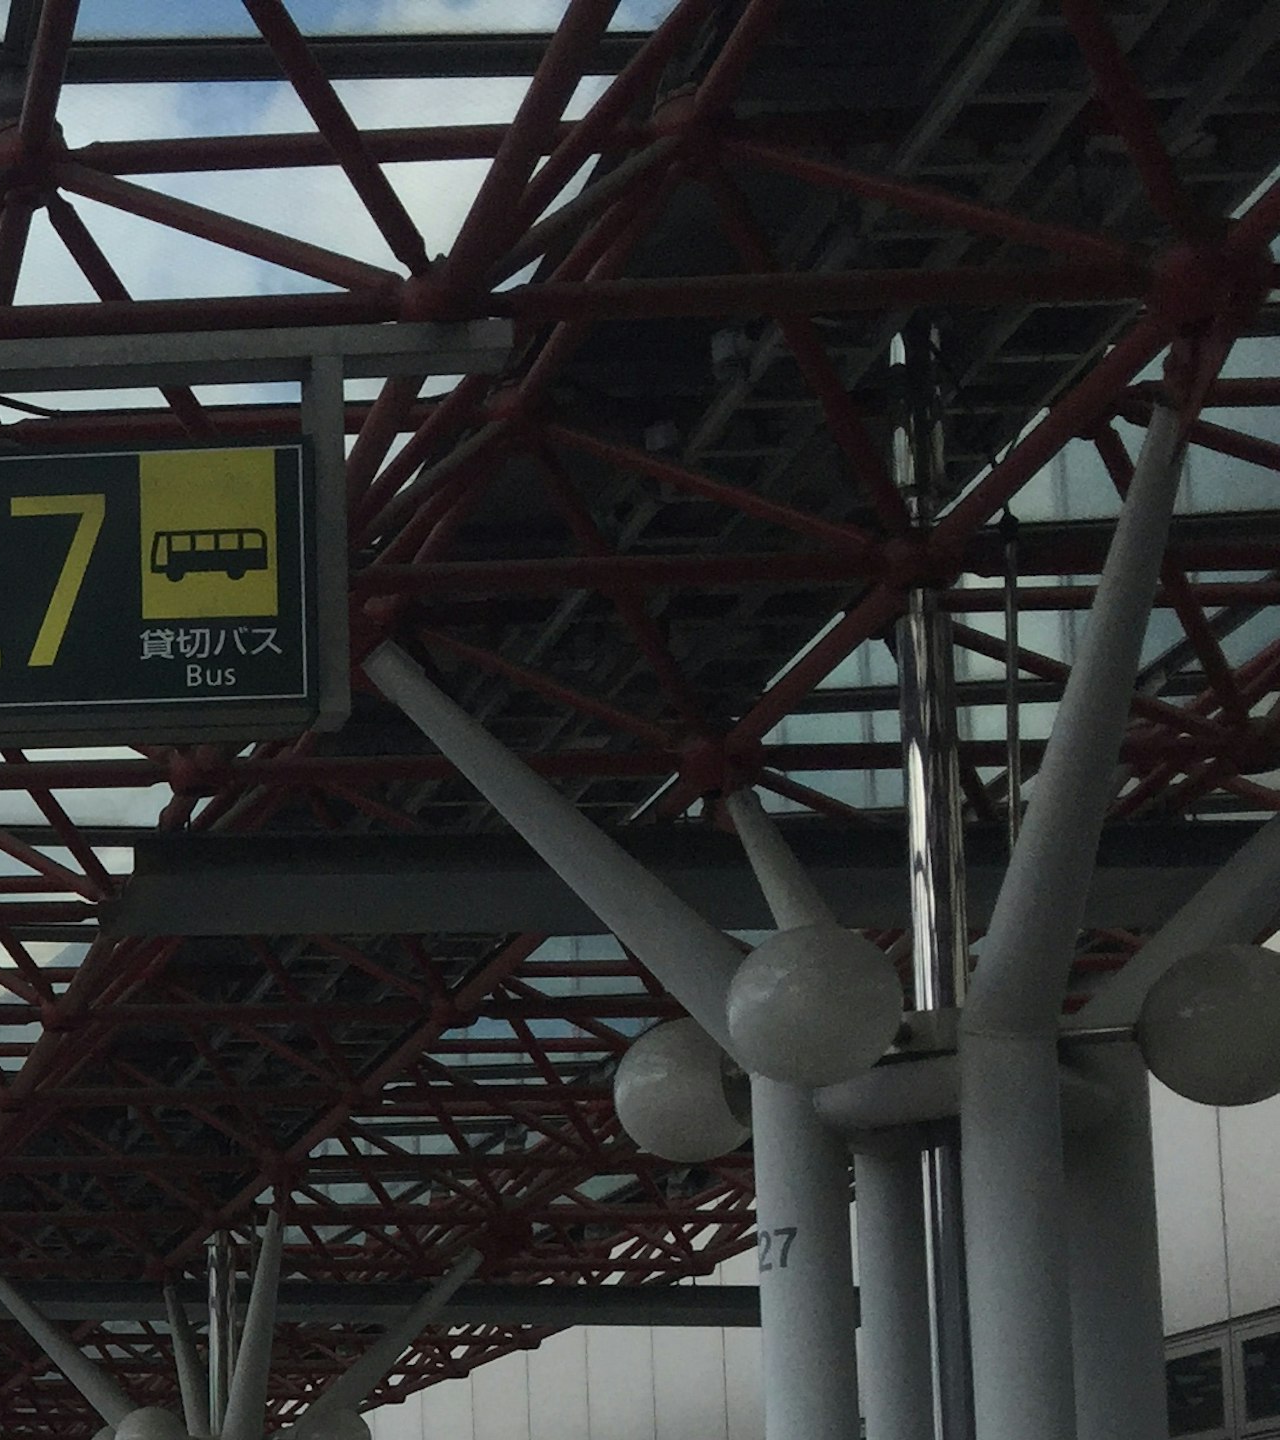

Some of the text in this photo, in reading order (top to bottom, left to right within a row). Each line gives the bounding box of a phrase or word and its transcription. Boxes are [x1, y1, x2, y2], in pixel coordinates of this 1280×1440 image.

[139, 627, 283, 661] 貸切バス
[186, 664, 237, 687] Bus
[759, 1227, 797, 1272] 27
